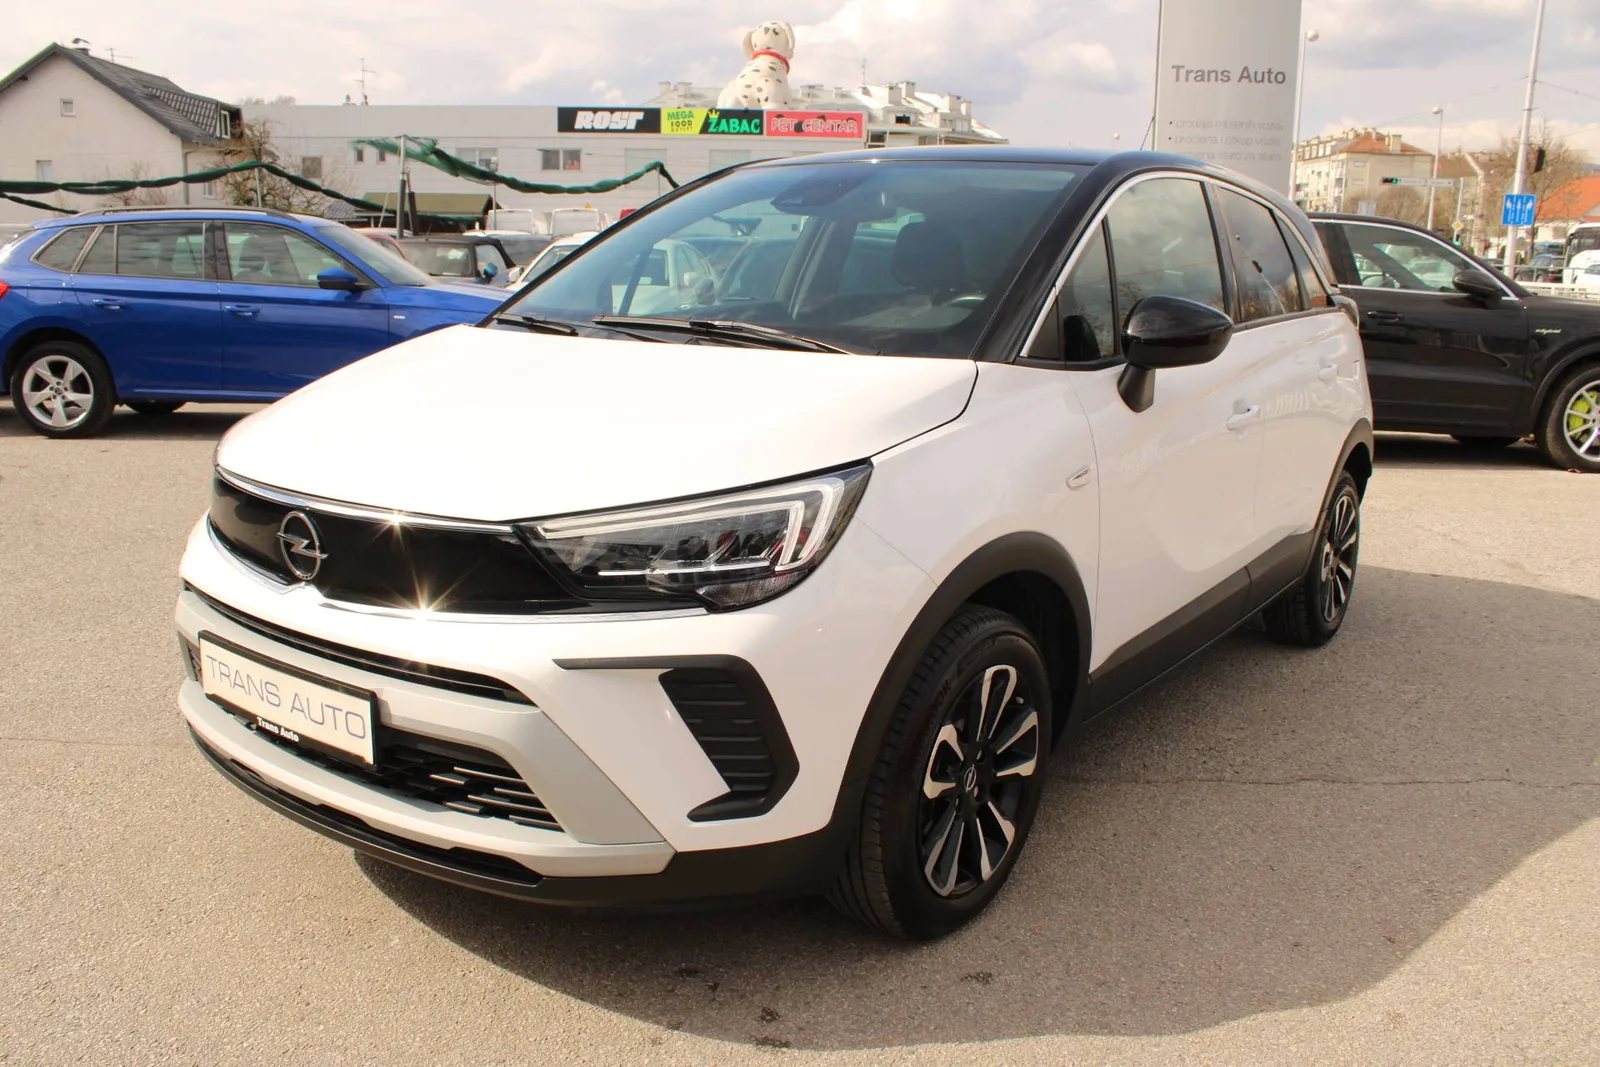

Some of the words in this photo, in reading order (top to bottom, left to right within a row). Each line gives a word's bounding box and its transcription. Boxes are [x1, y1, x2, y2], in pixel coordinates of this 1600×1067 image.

[1171, 65, 1231, 83] Trans
[1237, 66, 1286, 84] Auto
[667, 110, 694, 120] MEGA
[771, 117, 796, 132] PET
[802, 119, 858, 134] CENTAR
[205, 654, 281, 708] TRANS
[290, 692, 366, 740] AUTO
[256, 716, 279, 734] Trans
[280, 726, 299, 742] Auto
